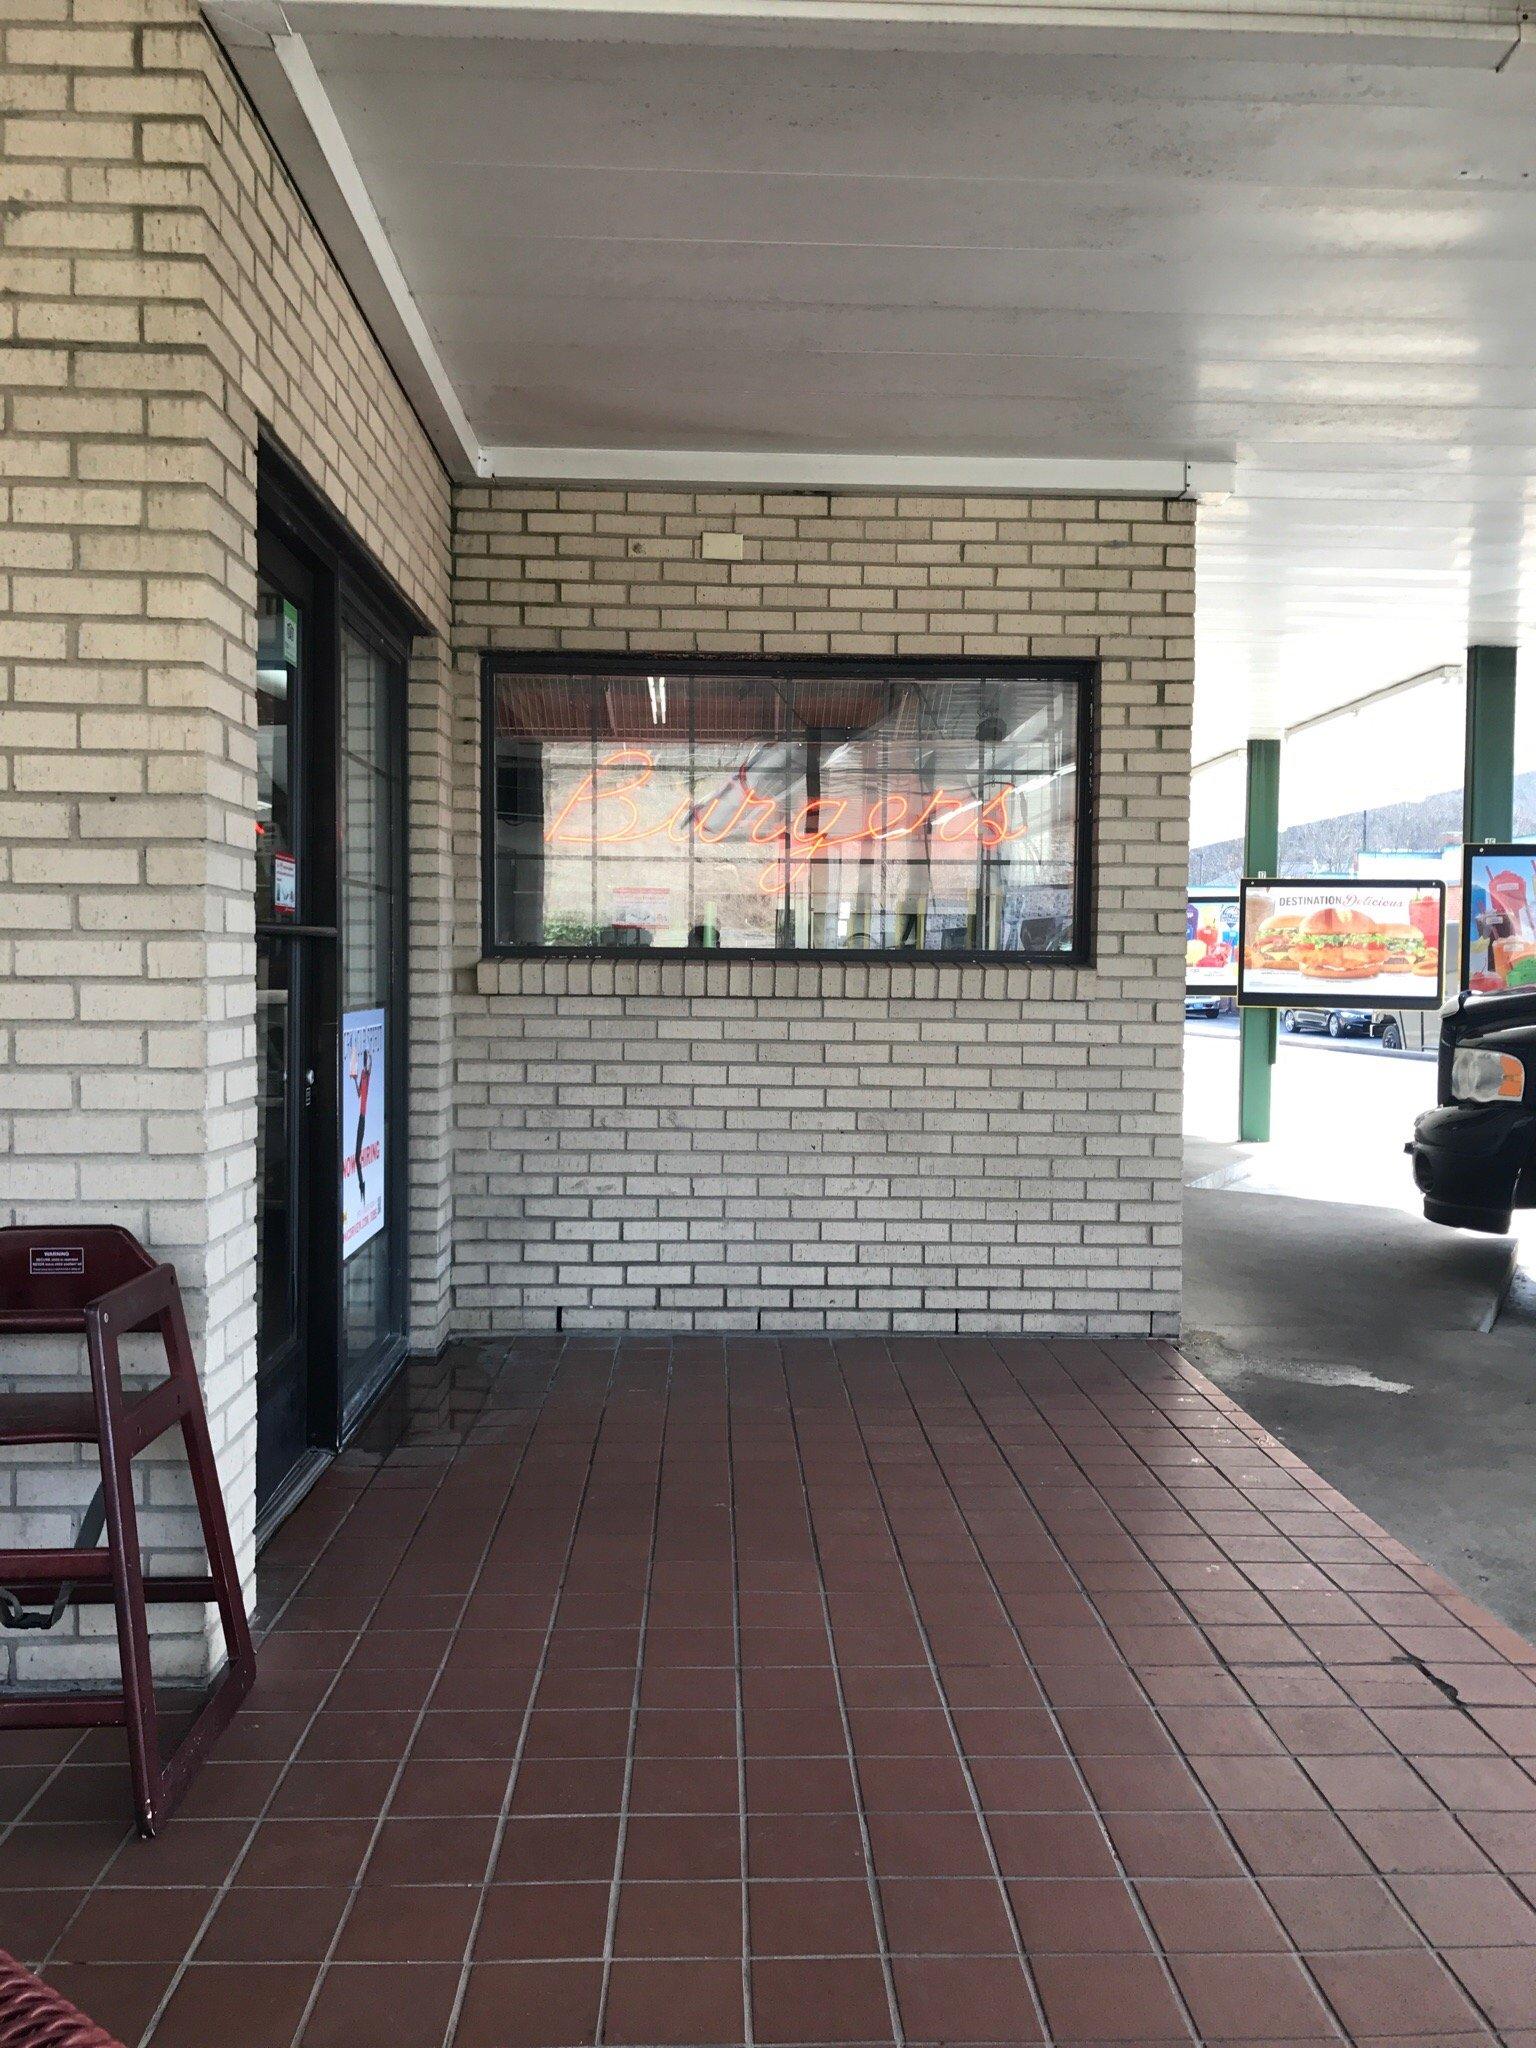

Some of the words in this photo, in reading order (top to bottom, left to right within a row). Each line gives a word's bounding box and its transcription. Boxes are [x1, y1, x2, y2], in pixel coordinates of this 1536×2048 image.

[545, 748, 1028, 893] Burgers
[1279, 895, 1342, 907] DESTINATION
[1342, 894, 1404, 907] Delicious
[360, 1141, 380, 1169] HIRING
